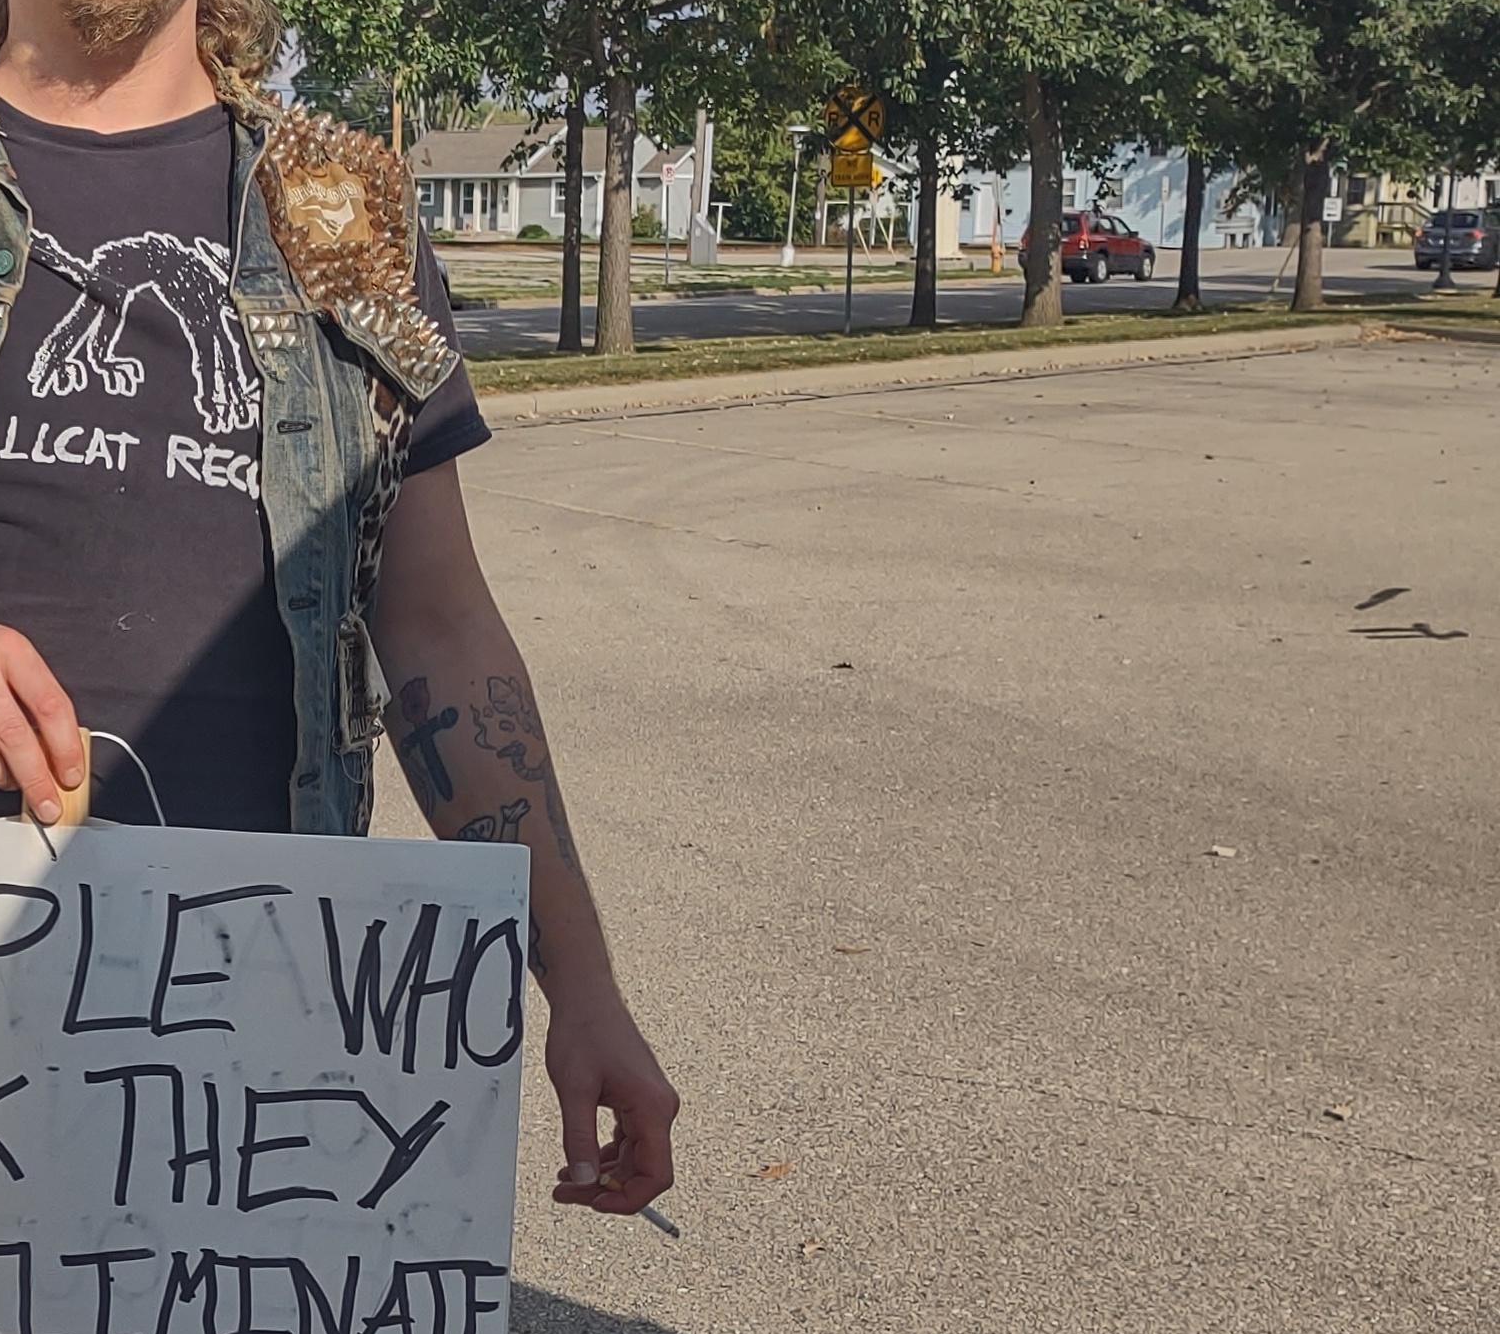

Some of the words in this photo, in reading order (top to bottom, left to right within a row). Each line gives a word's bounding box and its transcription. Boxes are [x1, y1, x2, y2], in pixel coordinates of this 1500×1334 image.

[867, 111, 879, 127] R
[318, 896, 523, 1075] WHO
[84, 1064, 451, 1210] THEY
